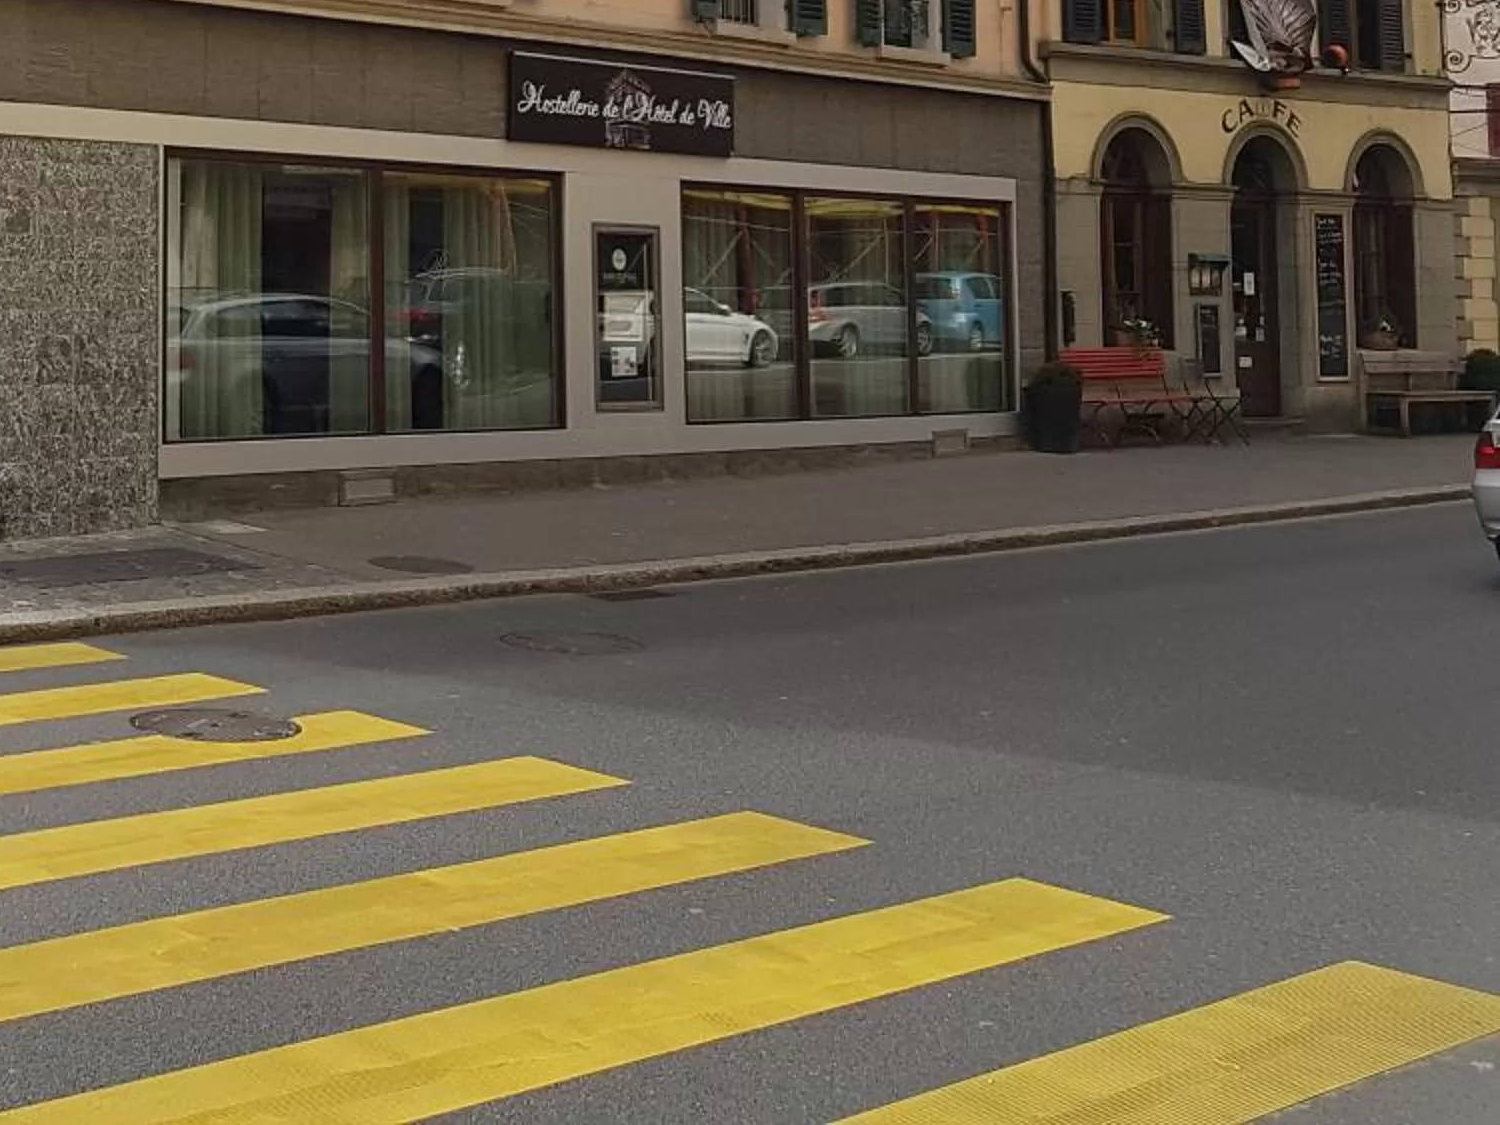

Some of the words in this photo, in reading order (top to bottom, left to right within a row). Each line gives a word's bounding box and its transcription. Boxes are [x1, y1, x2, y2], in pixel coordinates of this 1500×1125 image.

[517, 81, 599, 117] Hostellerie
[602, 95, 619, 118] de
[679, 102, 696, 125] de
[697, 99, 732, 130] Ville
